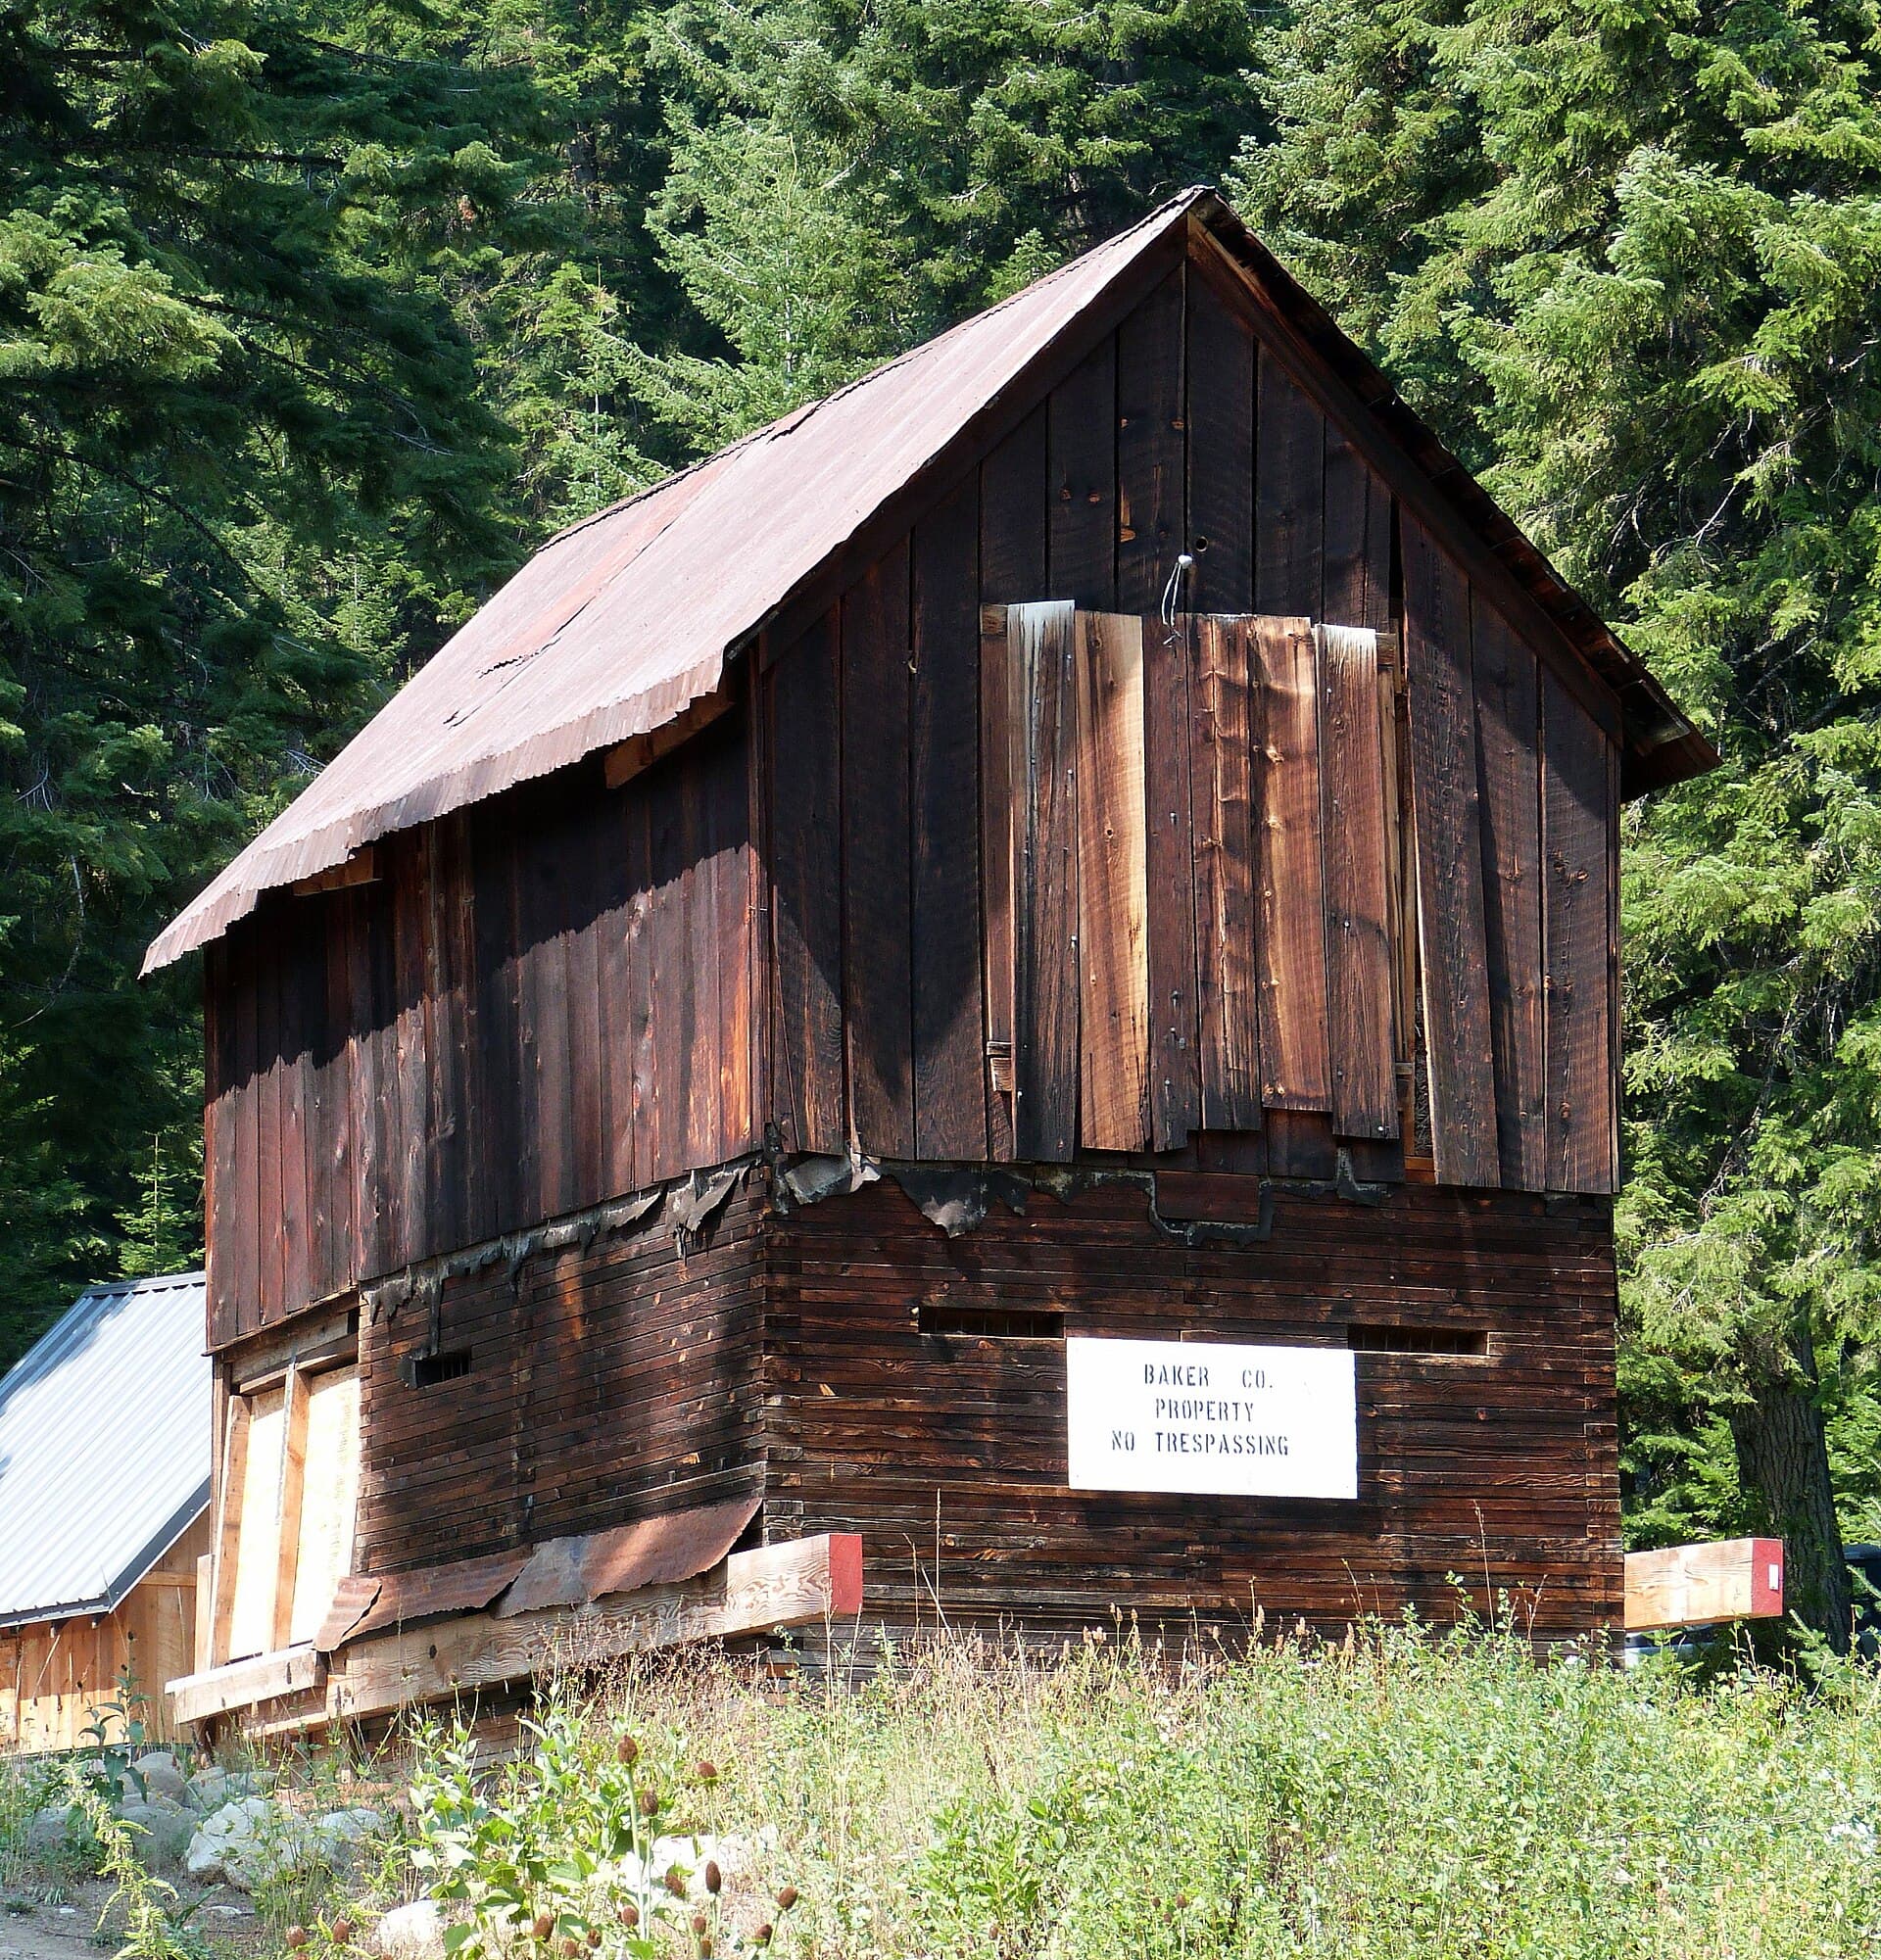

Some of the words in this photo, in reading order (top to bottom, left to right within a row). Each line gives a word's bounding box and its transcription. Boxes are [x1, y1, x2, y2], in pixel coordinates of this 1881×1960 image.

[1144, 1363, 1210, 1387] BAKER
[1241, 1369, 1274, 1389] CO.
[1155, 1398, 1254, 1422] PROPERTY
[1111, 1430, 1135, 1452] NO
[1154, 1431, 1289, 1457] TRESPASSING
